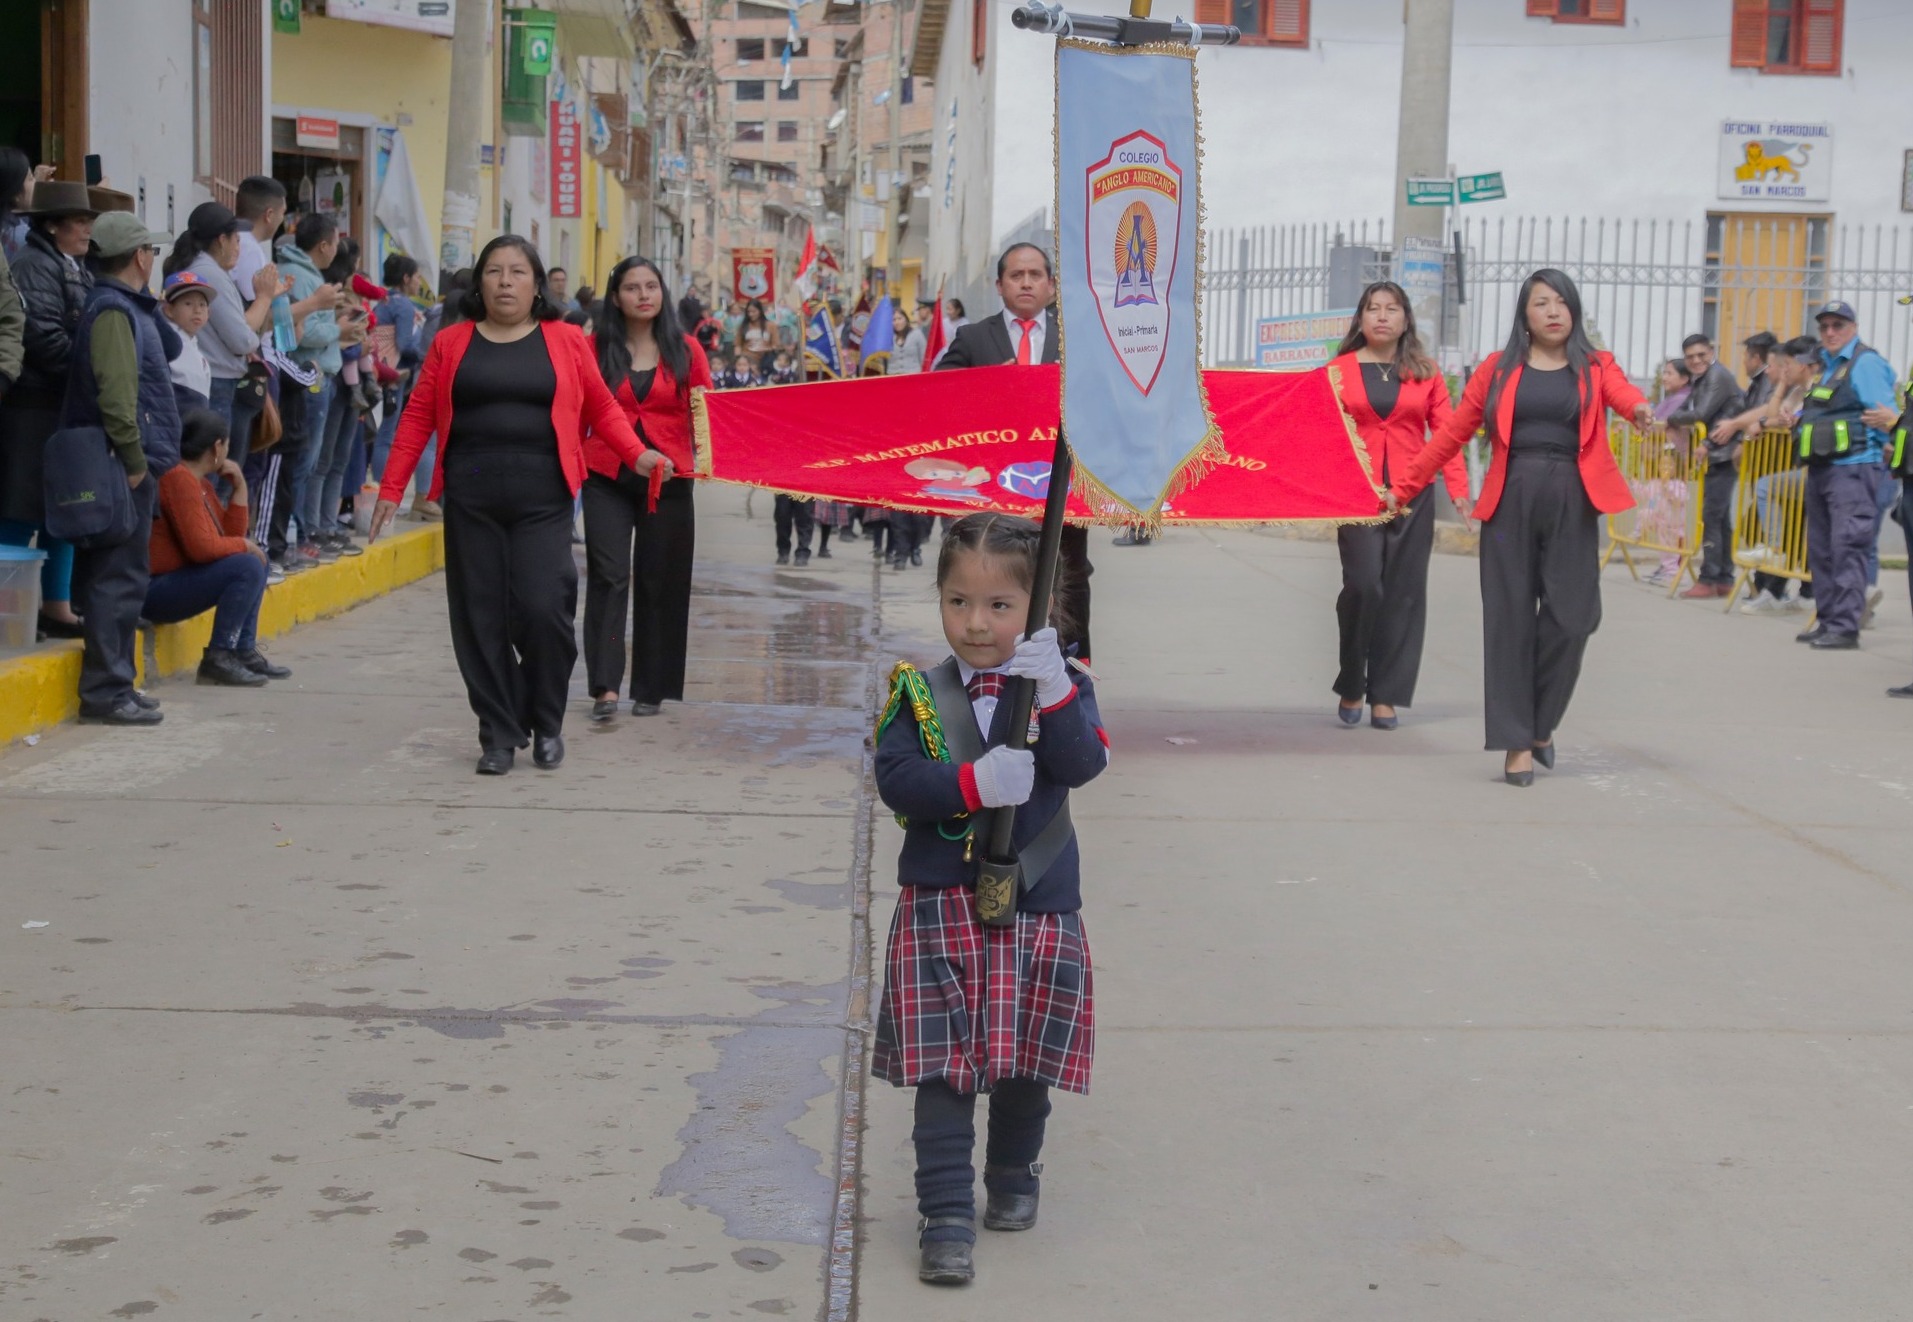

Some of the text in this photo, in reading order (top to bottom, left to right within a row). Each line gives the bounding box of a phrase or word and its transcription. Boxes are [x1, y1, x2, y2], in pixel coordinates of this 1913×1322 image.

[1724, 123, 1830, 137] OFICINA PARROQUIAL
[1119, 151, 1159, 164] COLEGIO
[558, 161, 576, 215] TOURS
[1741, 185, 1807, 197] SAN MARCOS
[1260, 320, 1307, 343] EXPRESS
[1136, 345, 1159, 354] MARCOS
[1263, 347, 1328, 364] BARRANCA
[852, 429, 1019, 463] MATEMATICO
